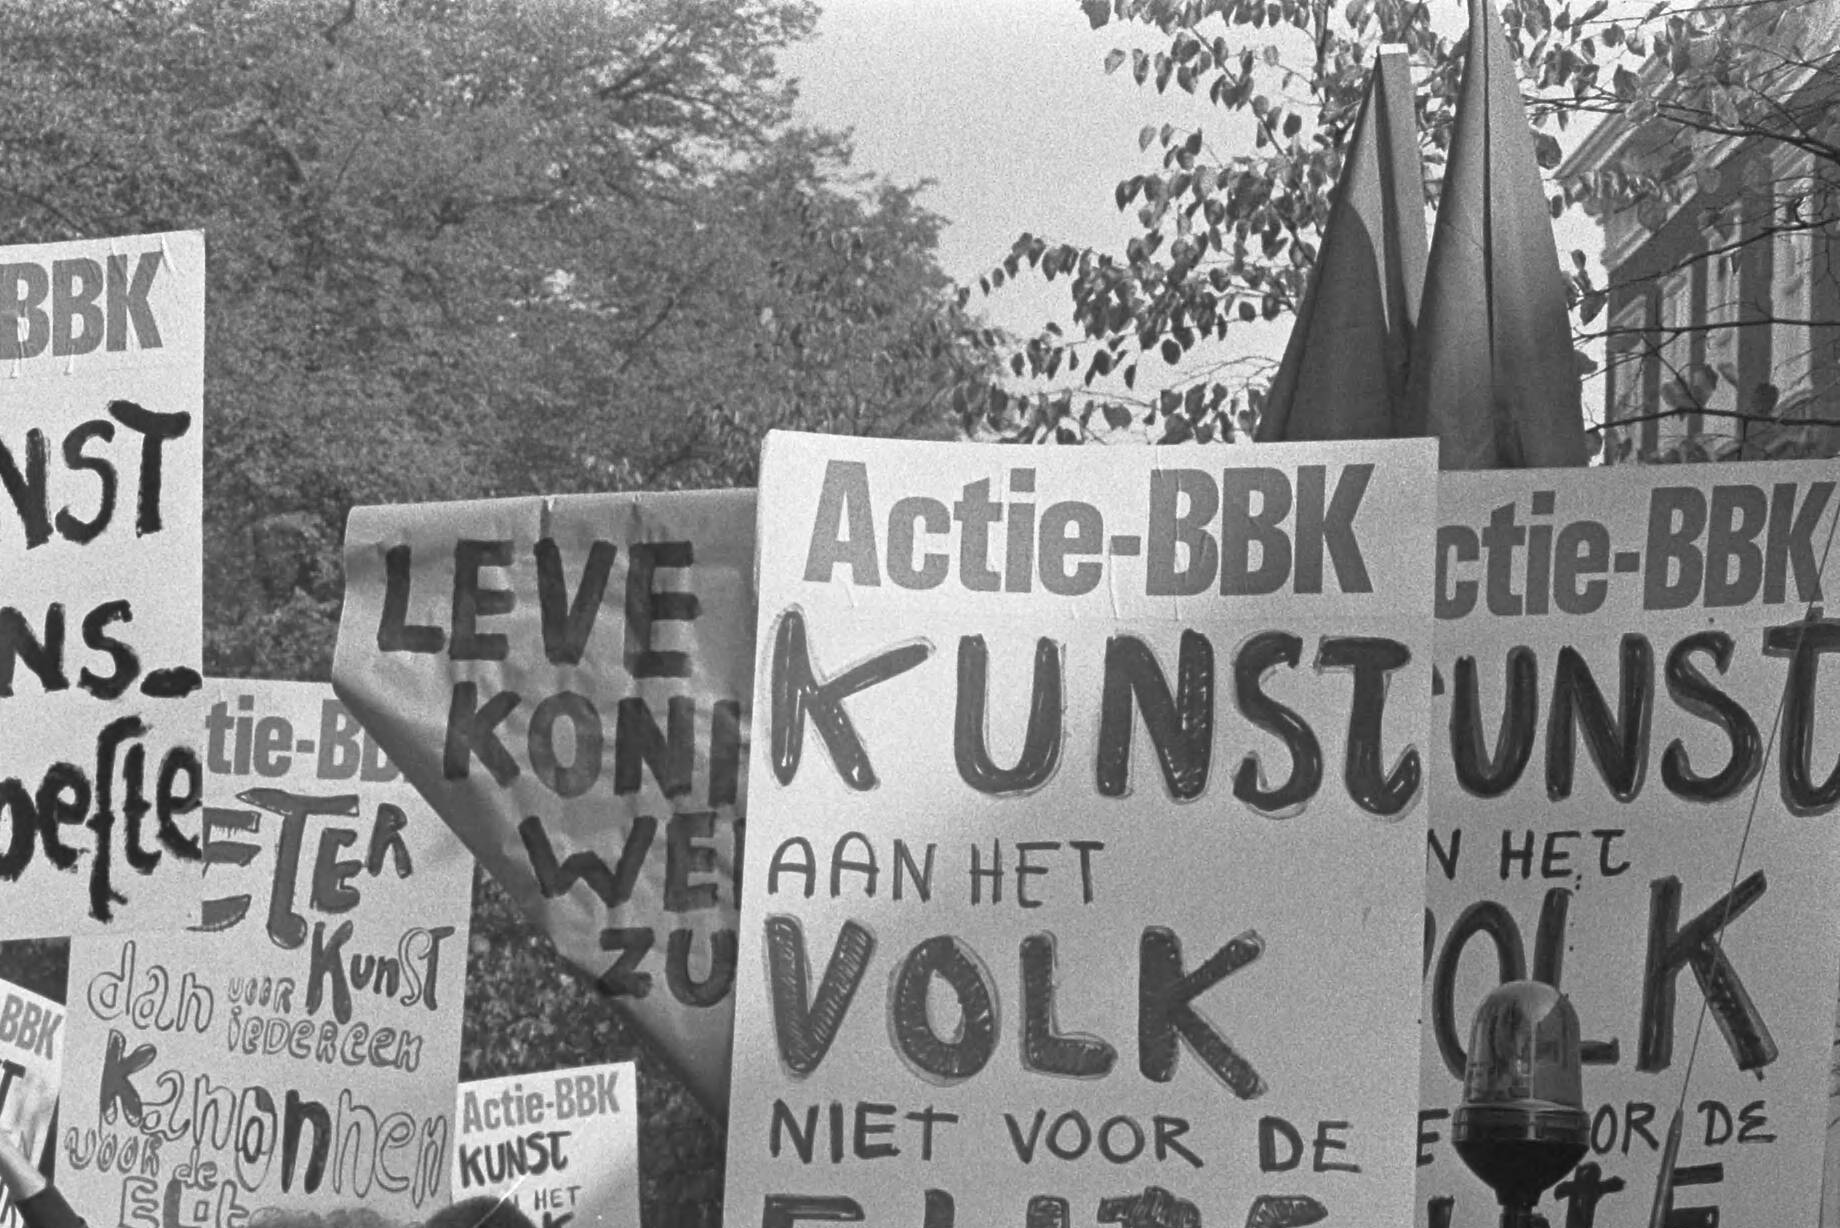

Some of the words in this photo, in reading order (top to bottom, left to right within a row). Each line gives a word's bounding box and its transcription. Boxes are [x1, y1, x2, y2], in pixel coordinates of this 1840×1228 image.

[803, 459, 1376, 597] Actie-BBK
[377, 537, 703, 679] LEVE
[768, 603, 1422, 820] KUNST
[767, 831, 937, 903] AAN
[970, 837, 1105, 909] HET
[87, 940, 214, 1033] dan
[762, 914, 1269, 1100] VOLK
[462, 1071, 621, 1135] Actie-BBK
[769, 1098, 959, 1164] NIET
[1004, 1107, 1204, 1169] VOOR
[1259, 1115, 1361, 1174] DE
[459, 1130, 573, 1189] KUNST
